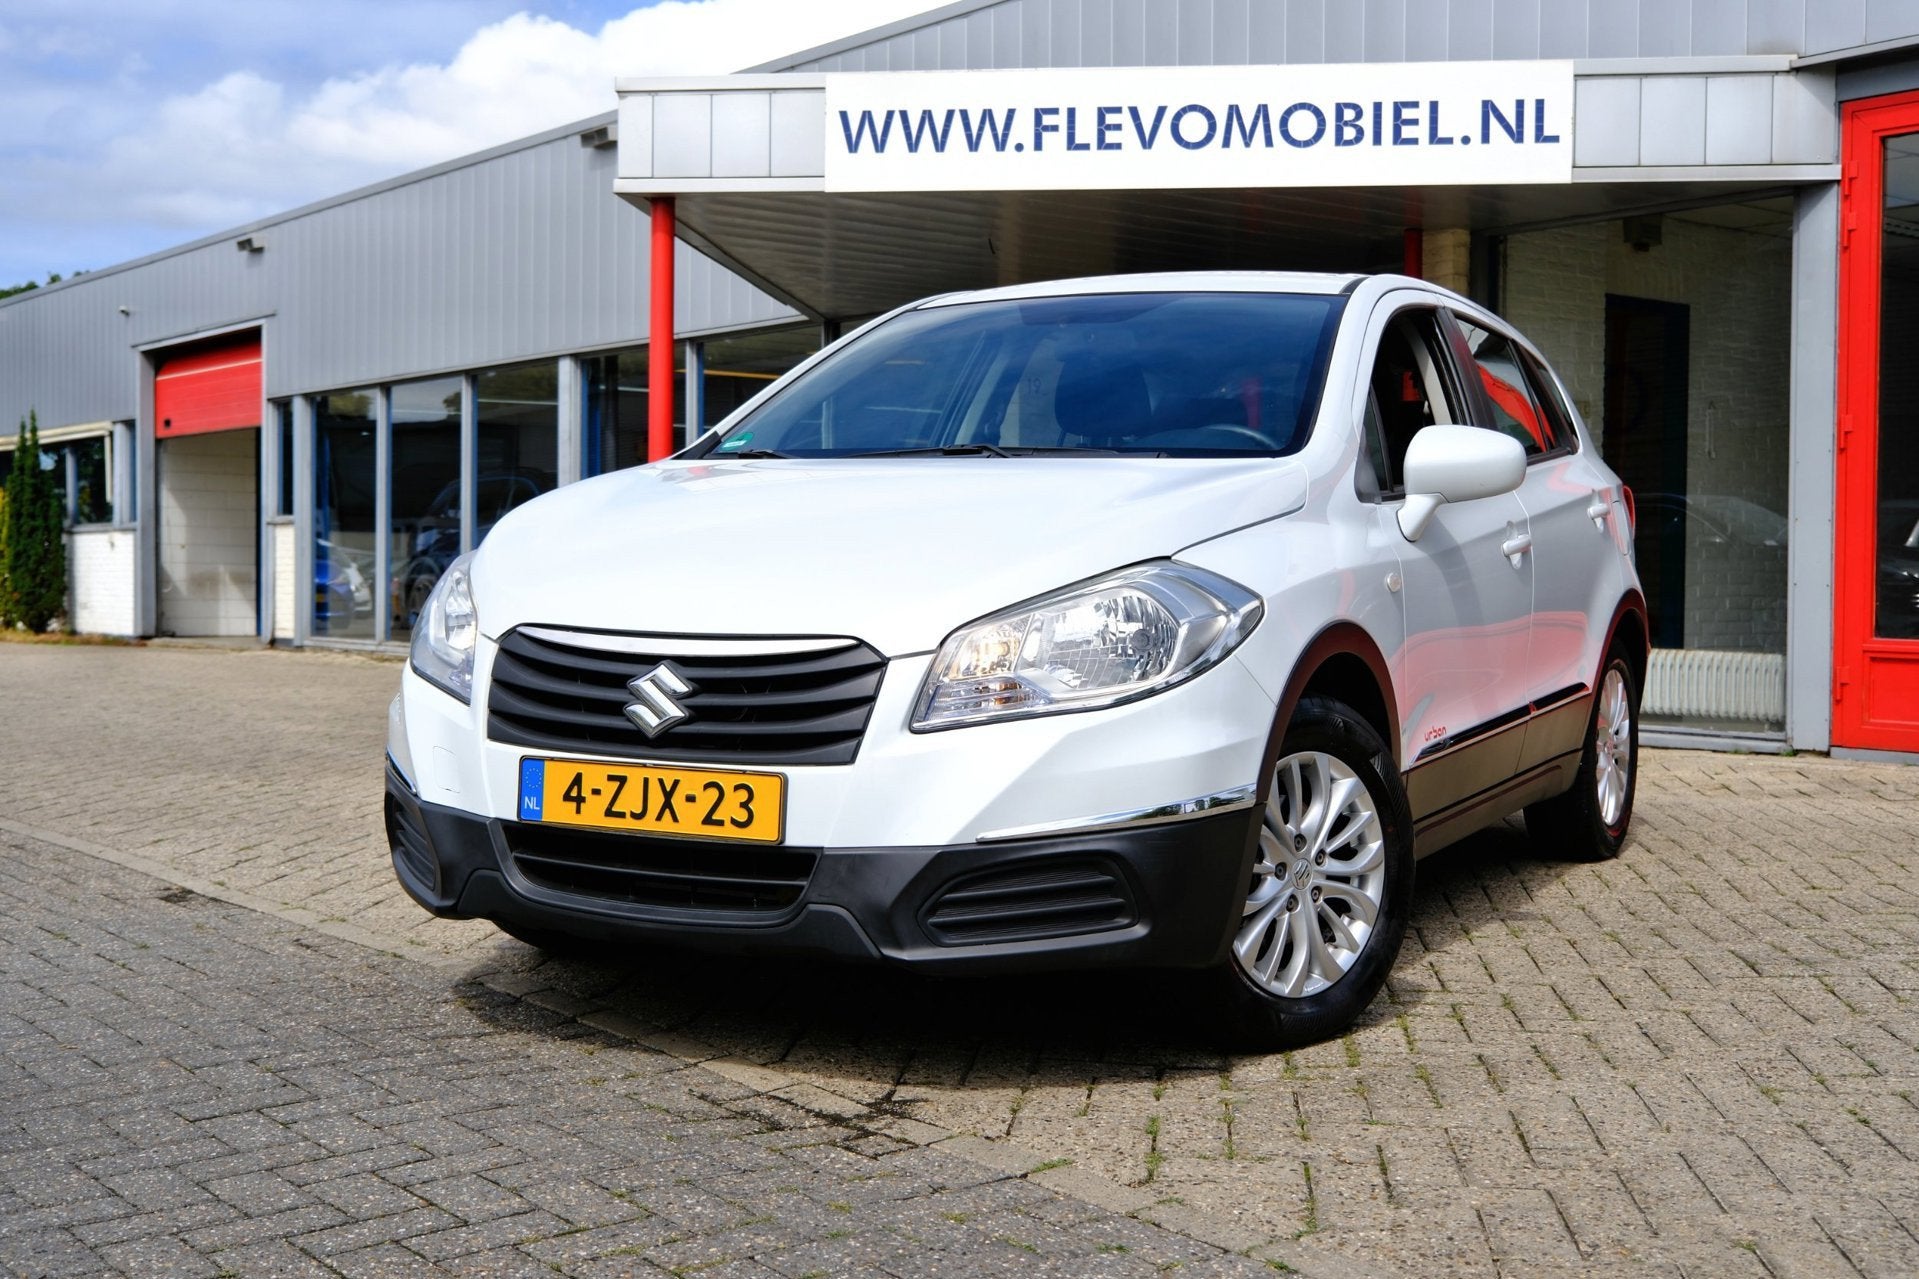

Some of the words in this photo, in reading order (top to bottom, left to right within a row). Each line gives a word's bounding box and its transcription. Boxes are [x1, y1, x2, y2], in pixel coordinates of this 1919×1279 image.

[838, 98, 1560, 154] WWW.FLEVOMOBIEL.NL
[1424, 726, 1447, 742] urban
[524, 796, 541, 811] NL
[562, 771, 756, 830] 4-ZJX-23
